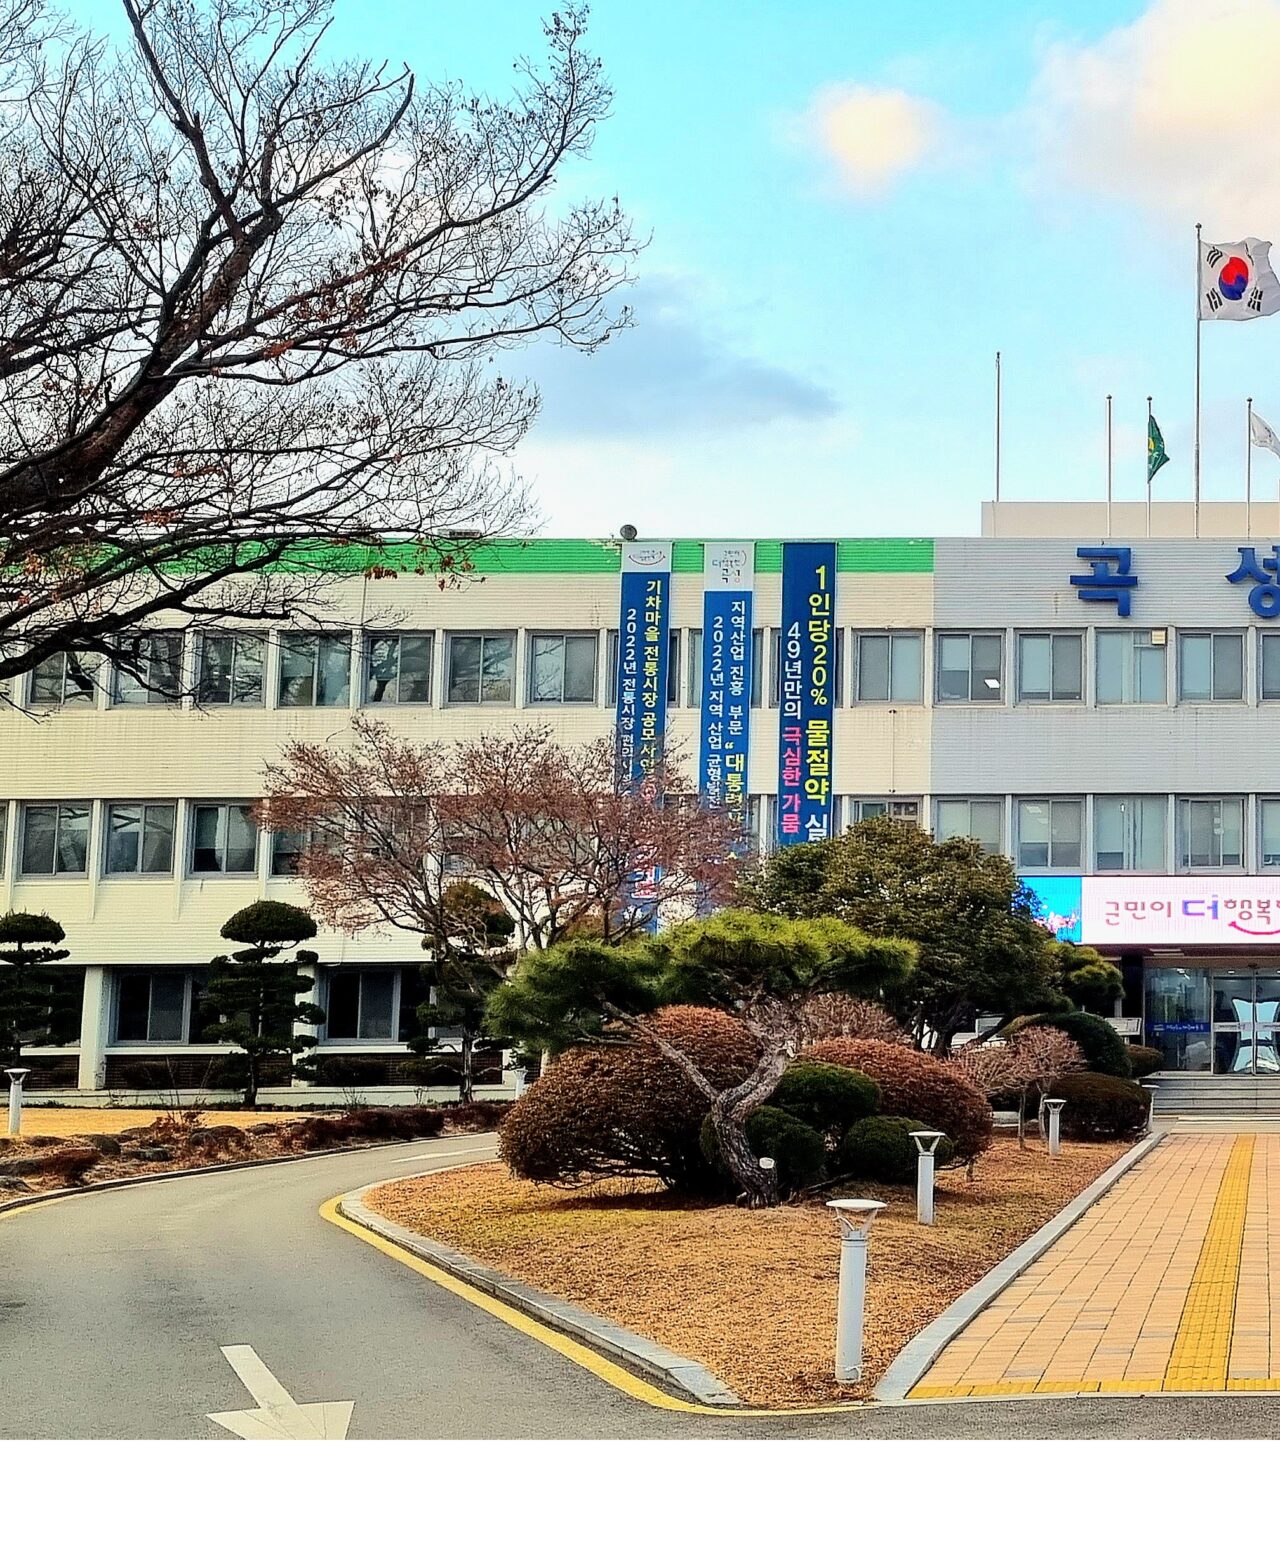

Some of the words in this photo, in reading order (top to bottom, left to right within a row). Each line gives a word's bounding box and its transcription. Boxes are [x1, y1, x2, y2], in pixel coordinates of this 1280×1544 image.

[622, 608, 637, 674] 2022년
[643, 580, 662, 642] 기차마을
[729, 600, 746, 662] 지역산업
[808, 565, 832, 706] 1인당20%
[642, 645, 659, 708] 전통시장
[709, 615, 724, 687] 2022년
[728, 665, 744, 697] 진흥
[783, 621, 803, 720] 49년만의
[620, 677, 636, 731] 전통시장
[640, 711, 657, 741] 공모
[708, 690, 723, 718] 지역
[727, 704, 743, 735] 부문
[707, 721, 723, 750] 산업
[781, 726, 802, 787] 극심한
[804, 719, 830, 807] 물절약
[780, 793, 801, 834] 가뭄
[1105, 900, 1171, 926] 군민이
[1181, 894, 1219, 920] 더
